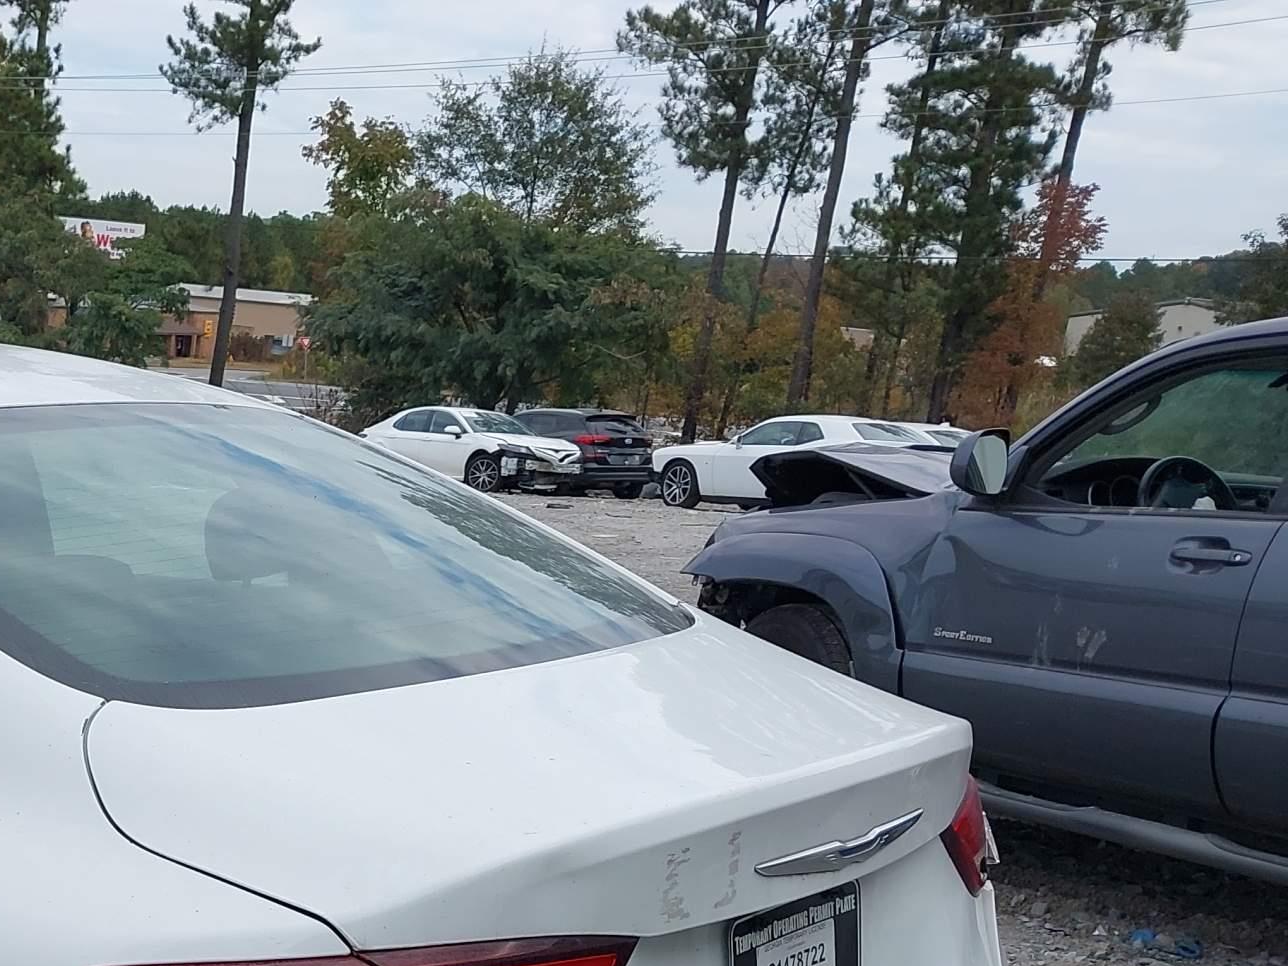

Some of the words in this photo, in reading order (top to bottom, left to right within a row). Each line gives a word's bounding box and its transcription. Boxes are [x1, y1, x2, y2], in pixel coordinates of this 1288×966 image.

[734, 925, 772, 956] TEMPORARY
[773, 911, 809, 939] OPERATING
[809, 901, 835, 925] PERMIT
[836, 894, 856, 916] PLATE
